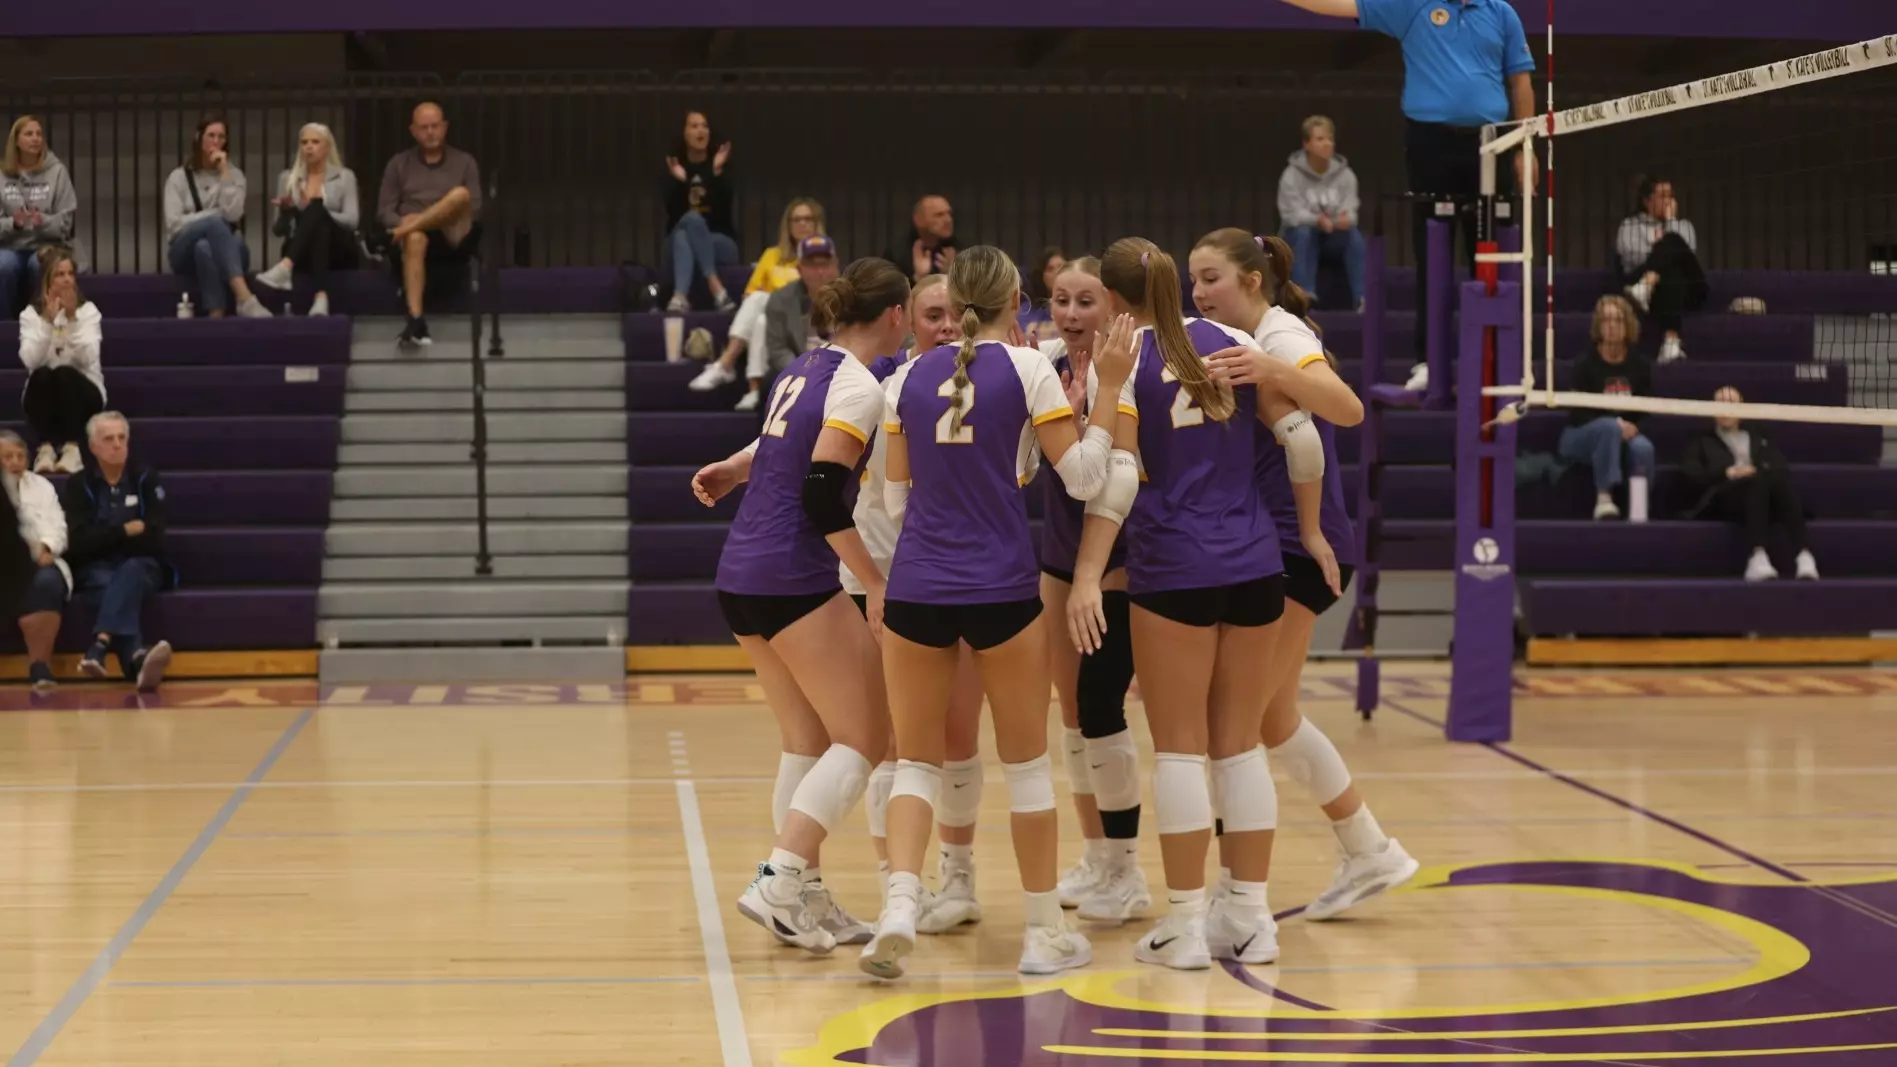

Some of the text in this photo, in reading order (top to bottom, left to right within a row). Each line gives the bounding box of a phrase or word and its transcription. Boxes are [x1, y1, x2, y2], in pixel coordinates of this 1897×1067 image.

[762, 374, 807, 438] 12
[935, 378, 976, 444] 2
[1160, 356, 1210, 429] 2
